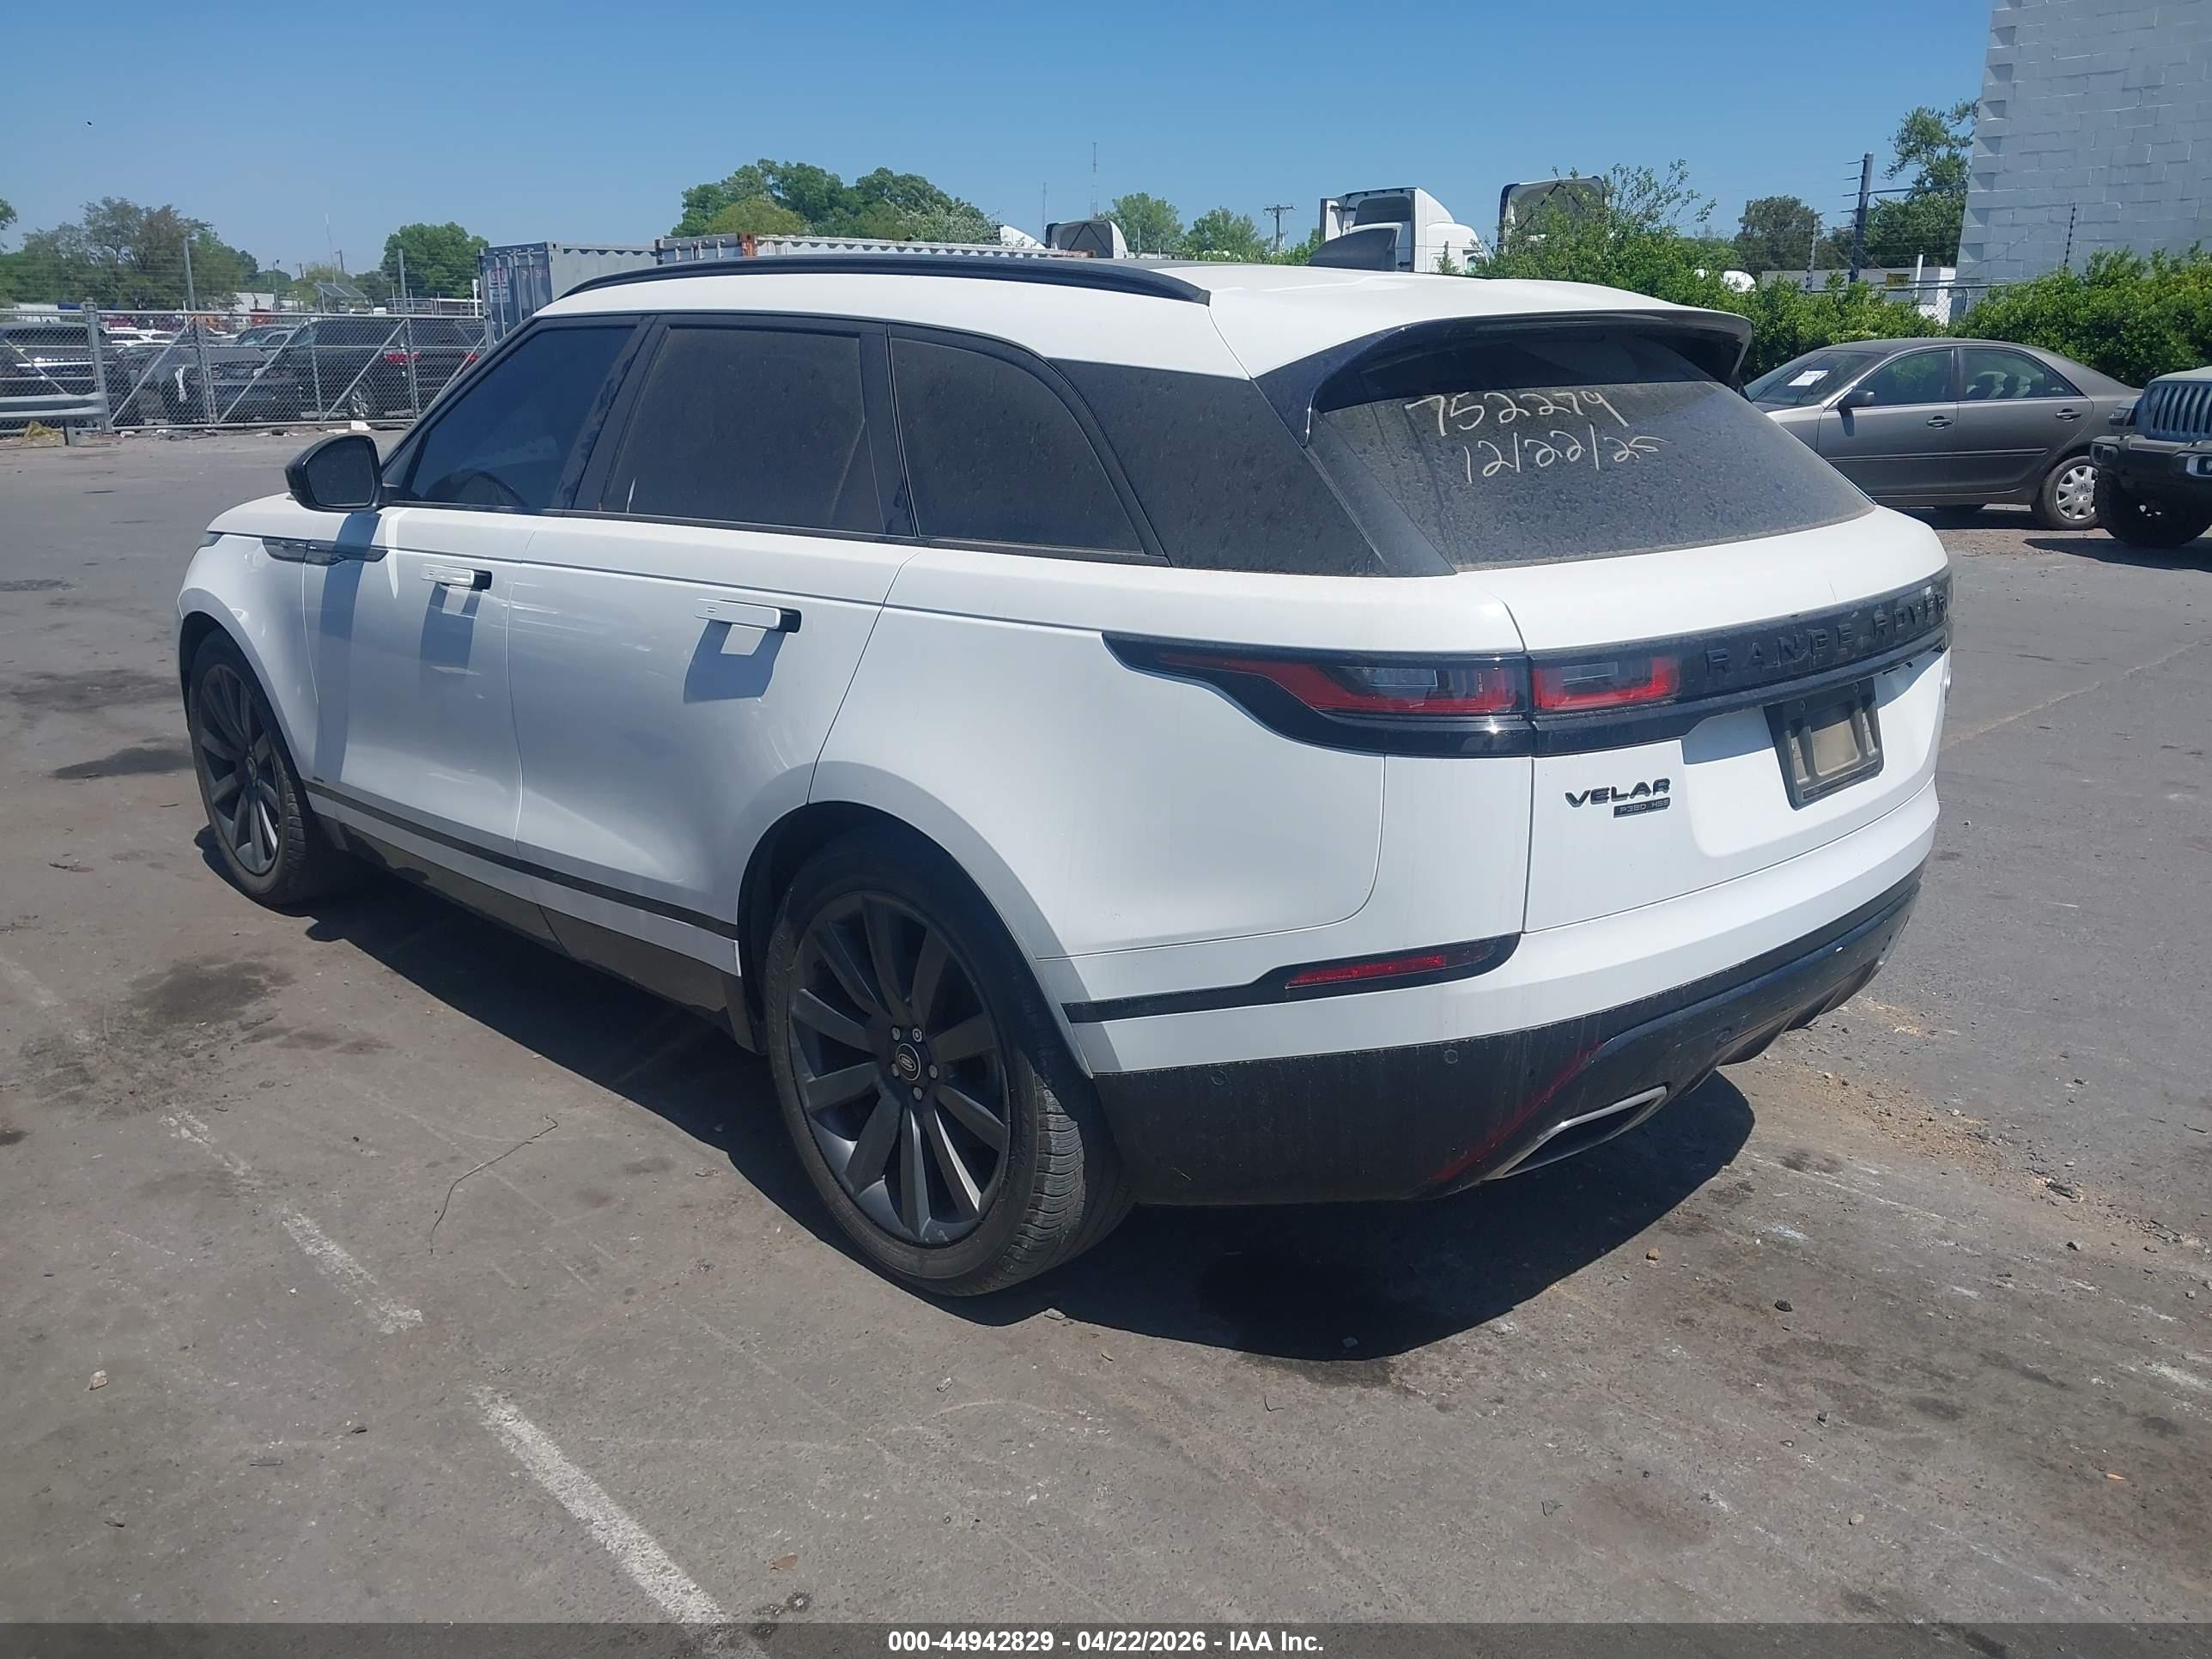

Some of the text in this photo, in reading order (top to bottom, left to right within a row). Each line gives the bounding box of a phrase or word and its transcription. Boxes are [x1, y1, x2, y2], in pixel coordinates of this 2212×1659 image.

[1404, 390, 1629, 436] 752279
[1705, 590, 1947, 675] RANGE ROVER
[1565, 777, 1670, 808] VELAR
[1651, 799, 1670, 809] HSE
